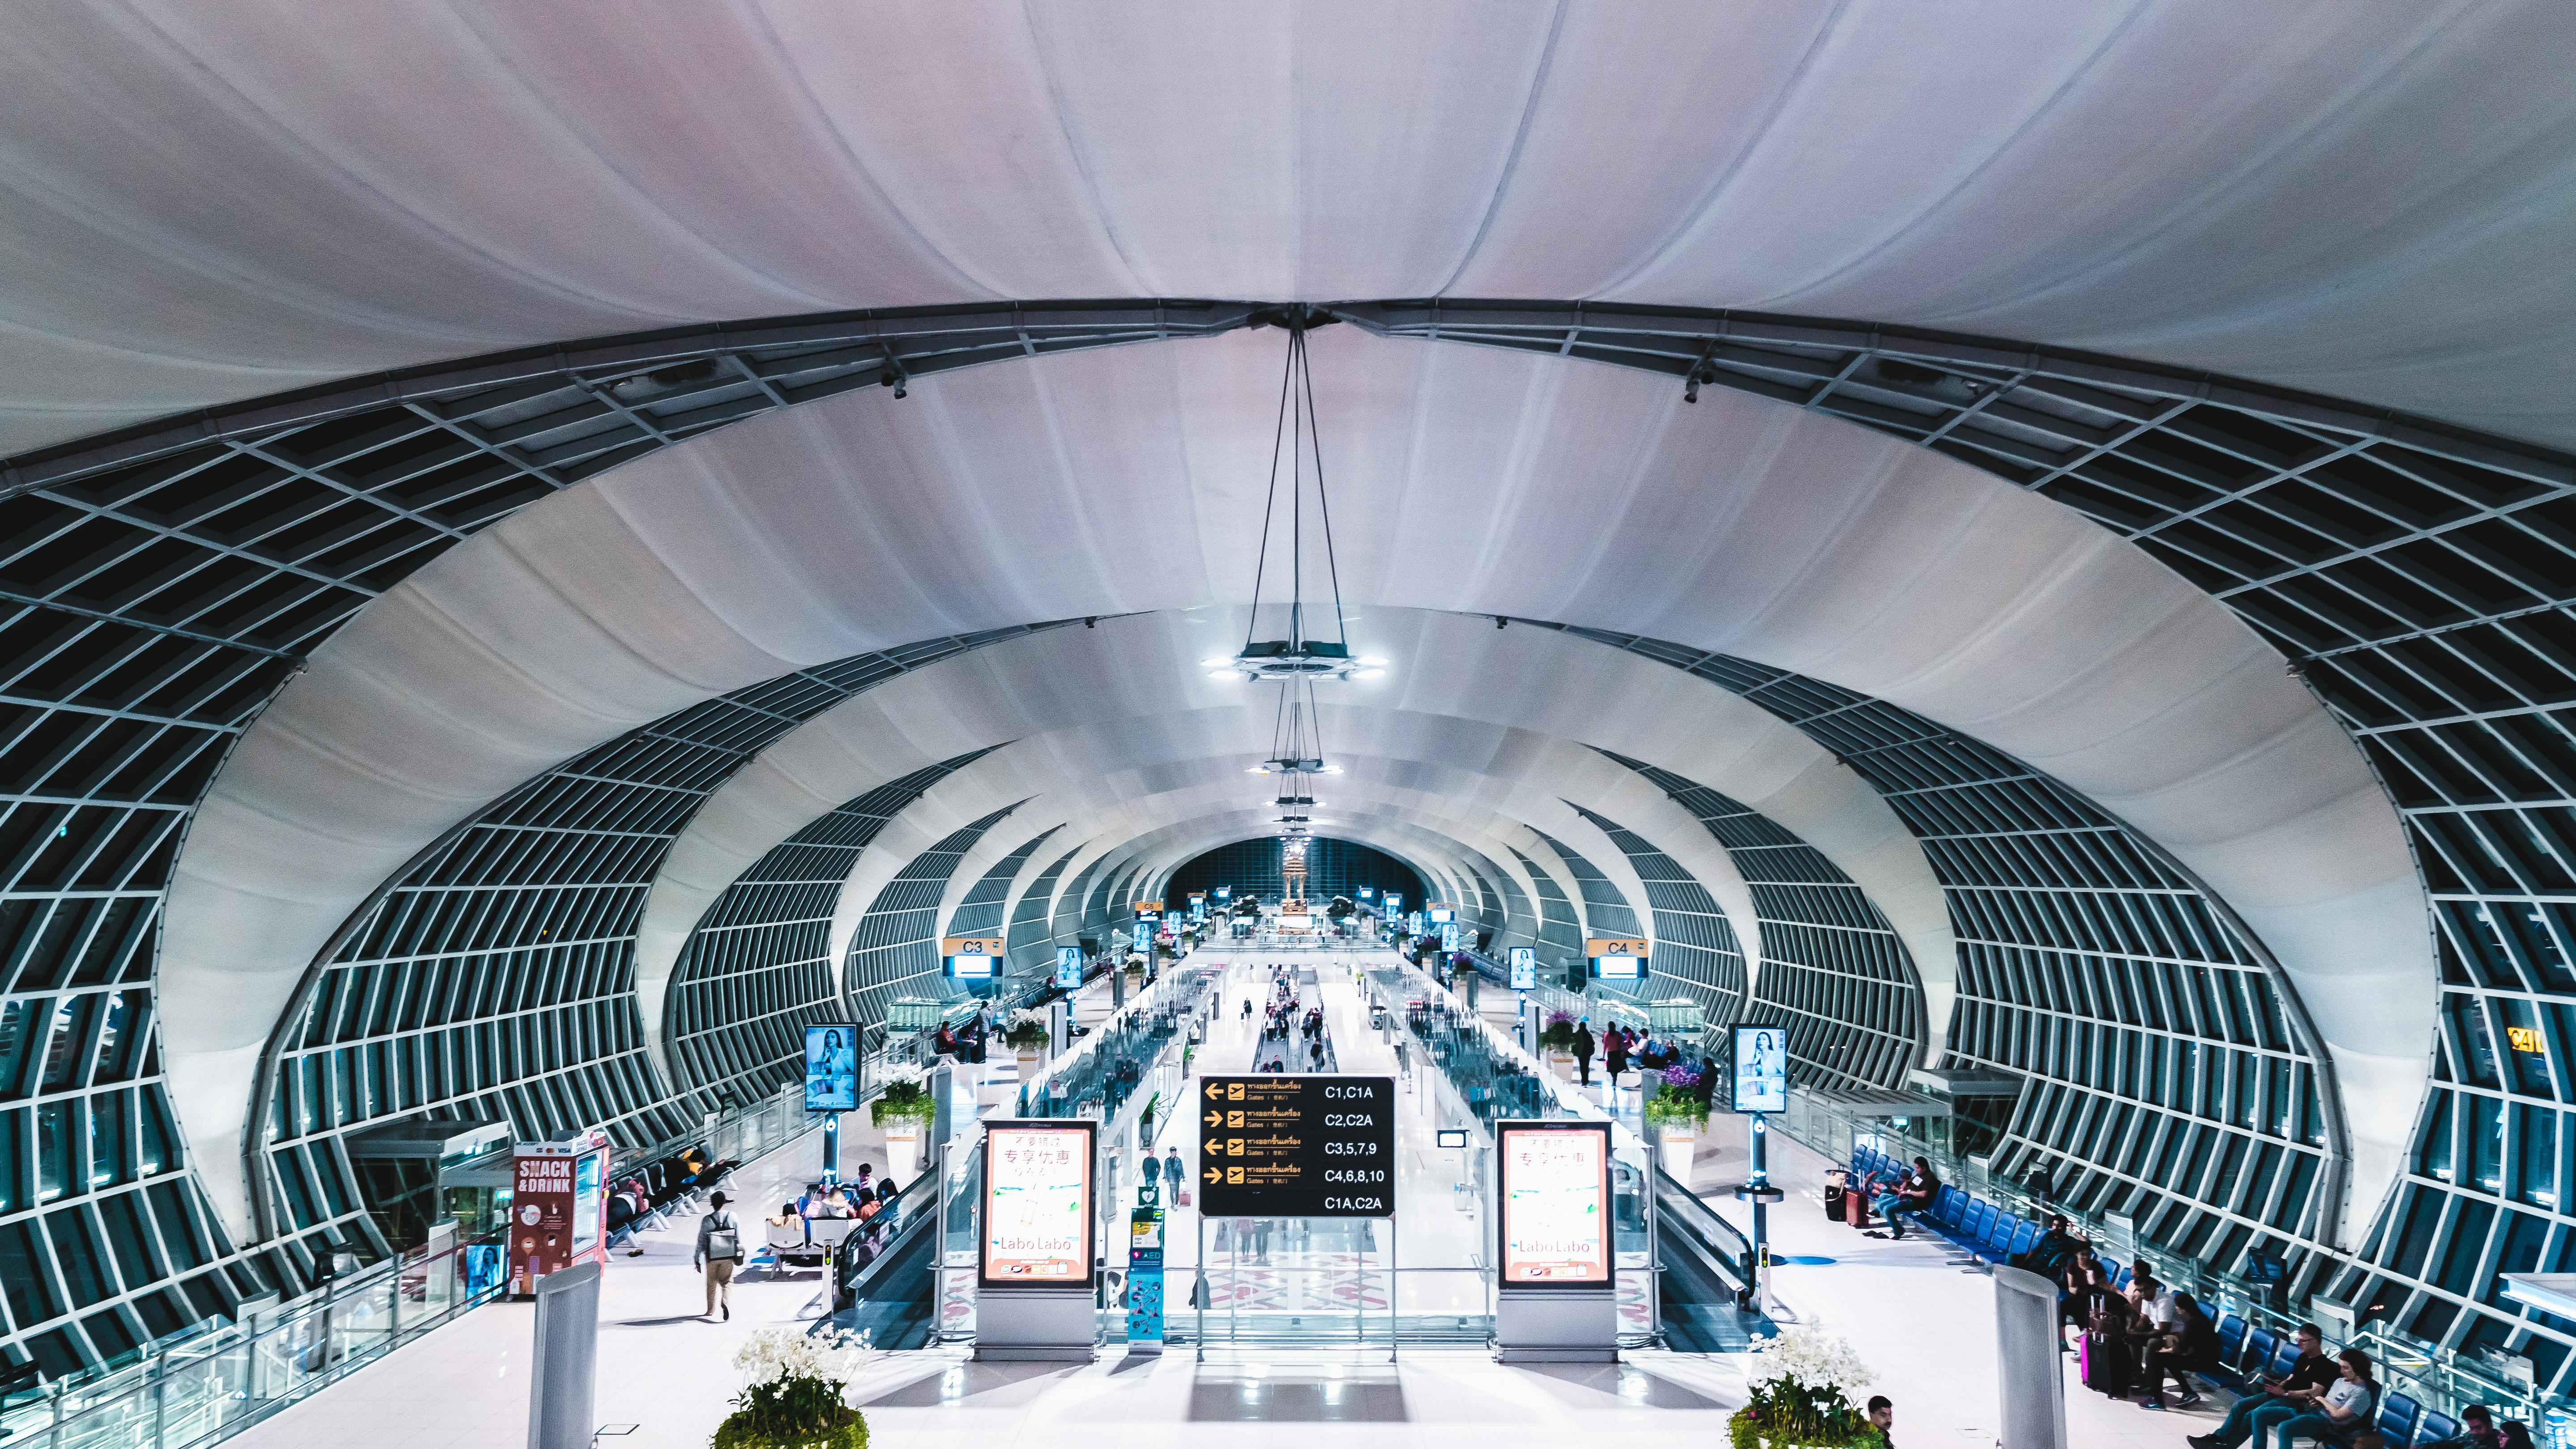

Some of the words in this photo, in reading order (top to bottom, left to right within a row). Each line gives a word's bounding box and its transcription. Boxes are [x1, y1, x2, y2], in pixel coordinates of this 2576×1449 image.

[963, 941, 983, 953] C3
[1608, 942, 1628, 954] C4
[1325, 1087, 1373, 1100] C1,C1A
[1325, 1114, 1373, 1128] C2,C2A
[1325, 1142, 1377, 1156] C3,5,7,9
[1004, 1149, 1070, 1164] 专享优惠
[1325, 1170, 1384, 1184] C4,6,8,10
[1325, 1197, 1382, 1210] C1A,C2A
